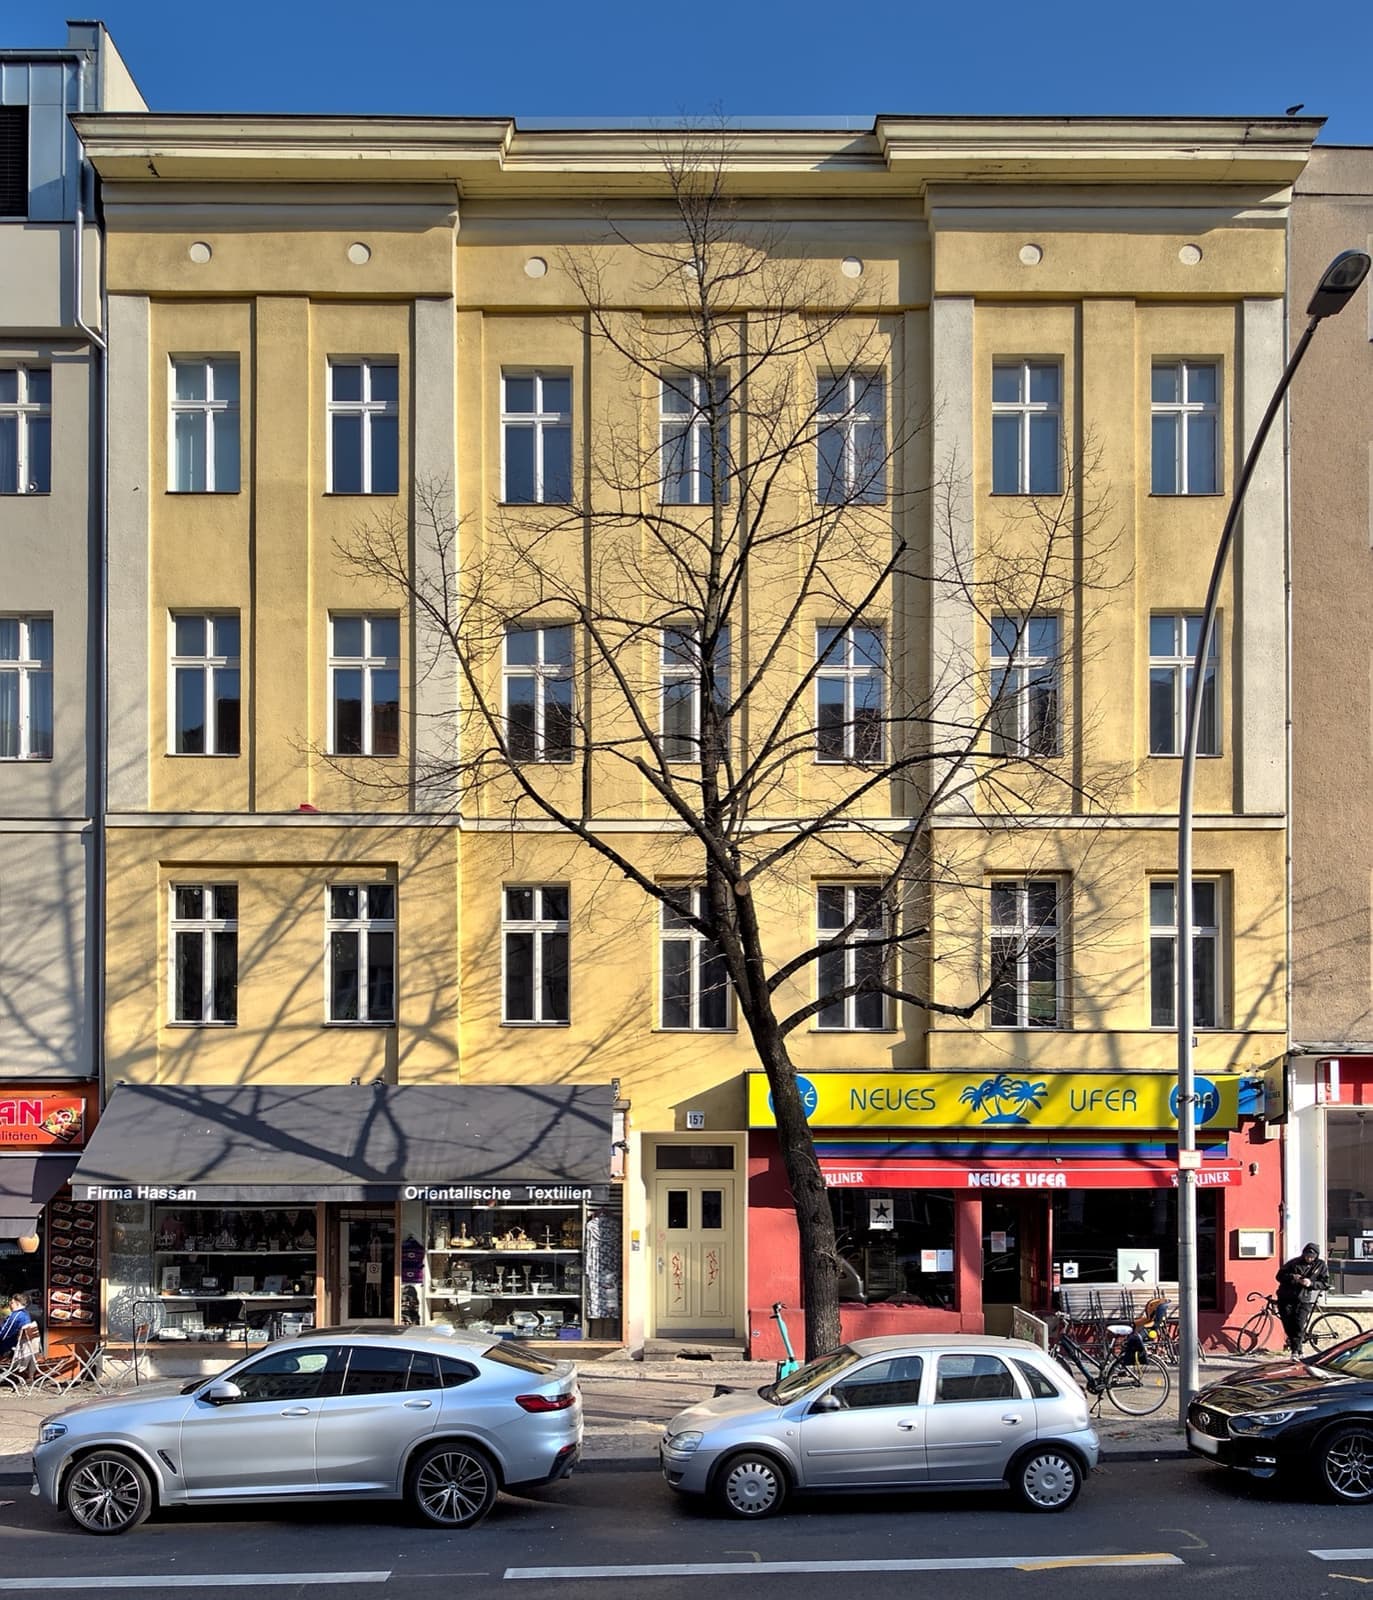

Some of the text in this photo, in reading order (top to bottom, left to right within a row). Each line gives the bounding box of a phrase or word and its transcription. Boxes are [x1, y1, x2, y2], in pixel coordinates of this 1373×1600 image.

[850, 1088, 1137, 1112] NEUES UFER
[1175, 1091, 1214, 1109] AR
[689, 1114, 704, 1125] 157
[0, 1129, 38, 1141] litäten
[822, 1171, 864, 1187] RLINER
[968, 1172, 1066, 1188] NEUES UFER
[87, 1186, 197, 1200] Firma Hassan
[404, 1186, 592, 1200] Orientalische Textilien
